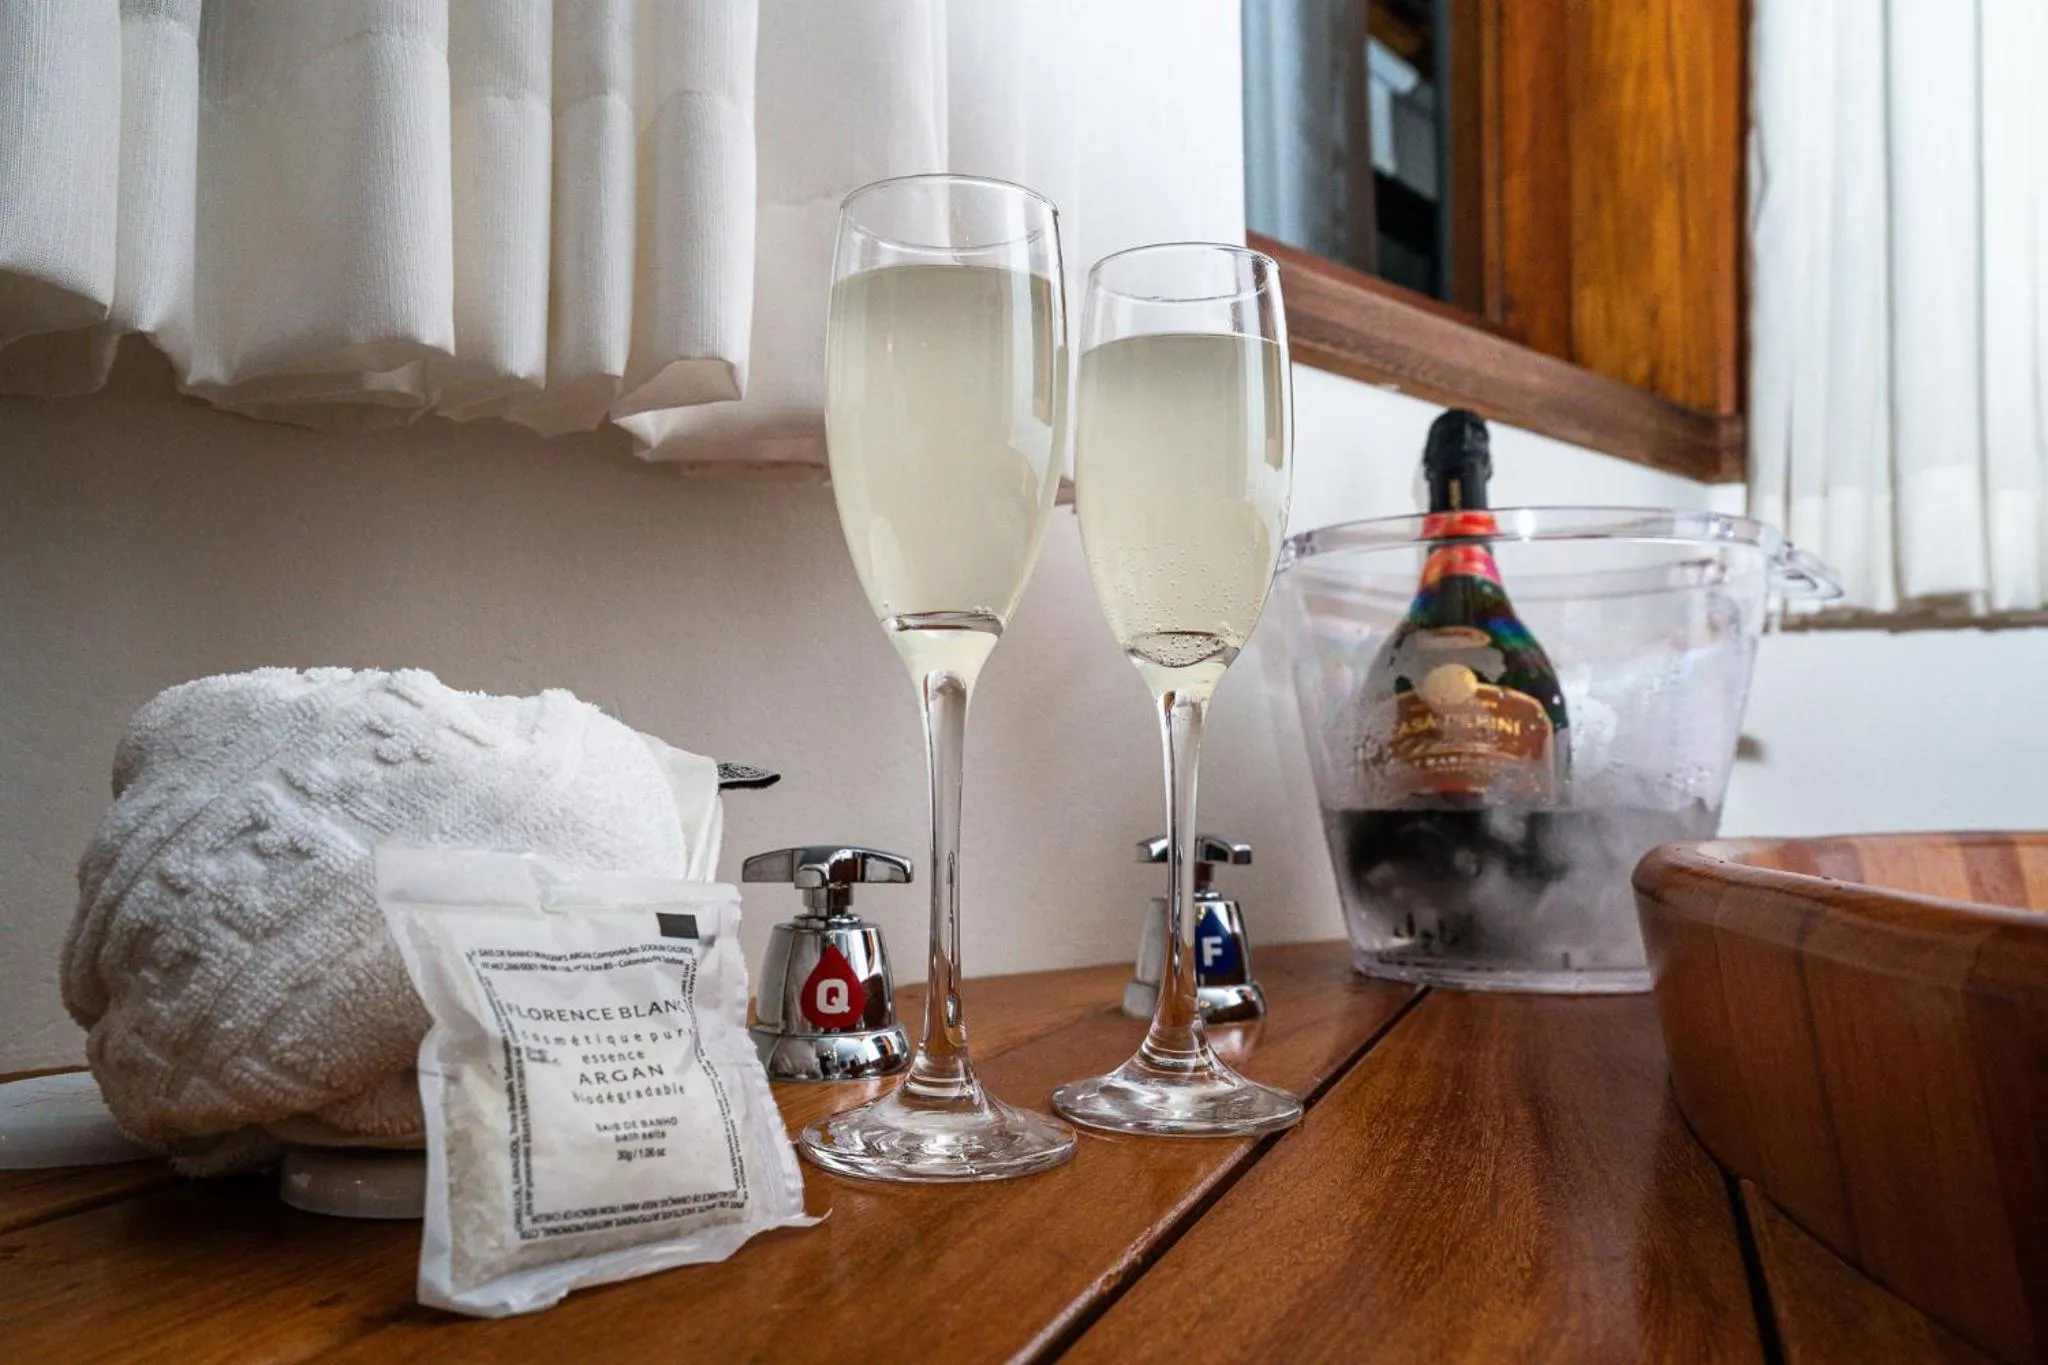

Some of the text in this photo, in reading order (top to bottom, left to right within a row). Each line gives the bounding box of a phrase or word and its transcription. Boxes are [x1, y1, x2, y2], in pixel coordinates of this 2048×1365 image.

[1202, 936, 1224, 967] F
[815, 978, 852, 1015] Q
[581, 1049, 646, 1065] essence
[579, 1064, 664, 1086] ARGAN
